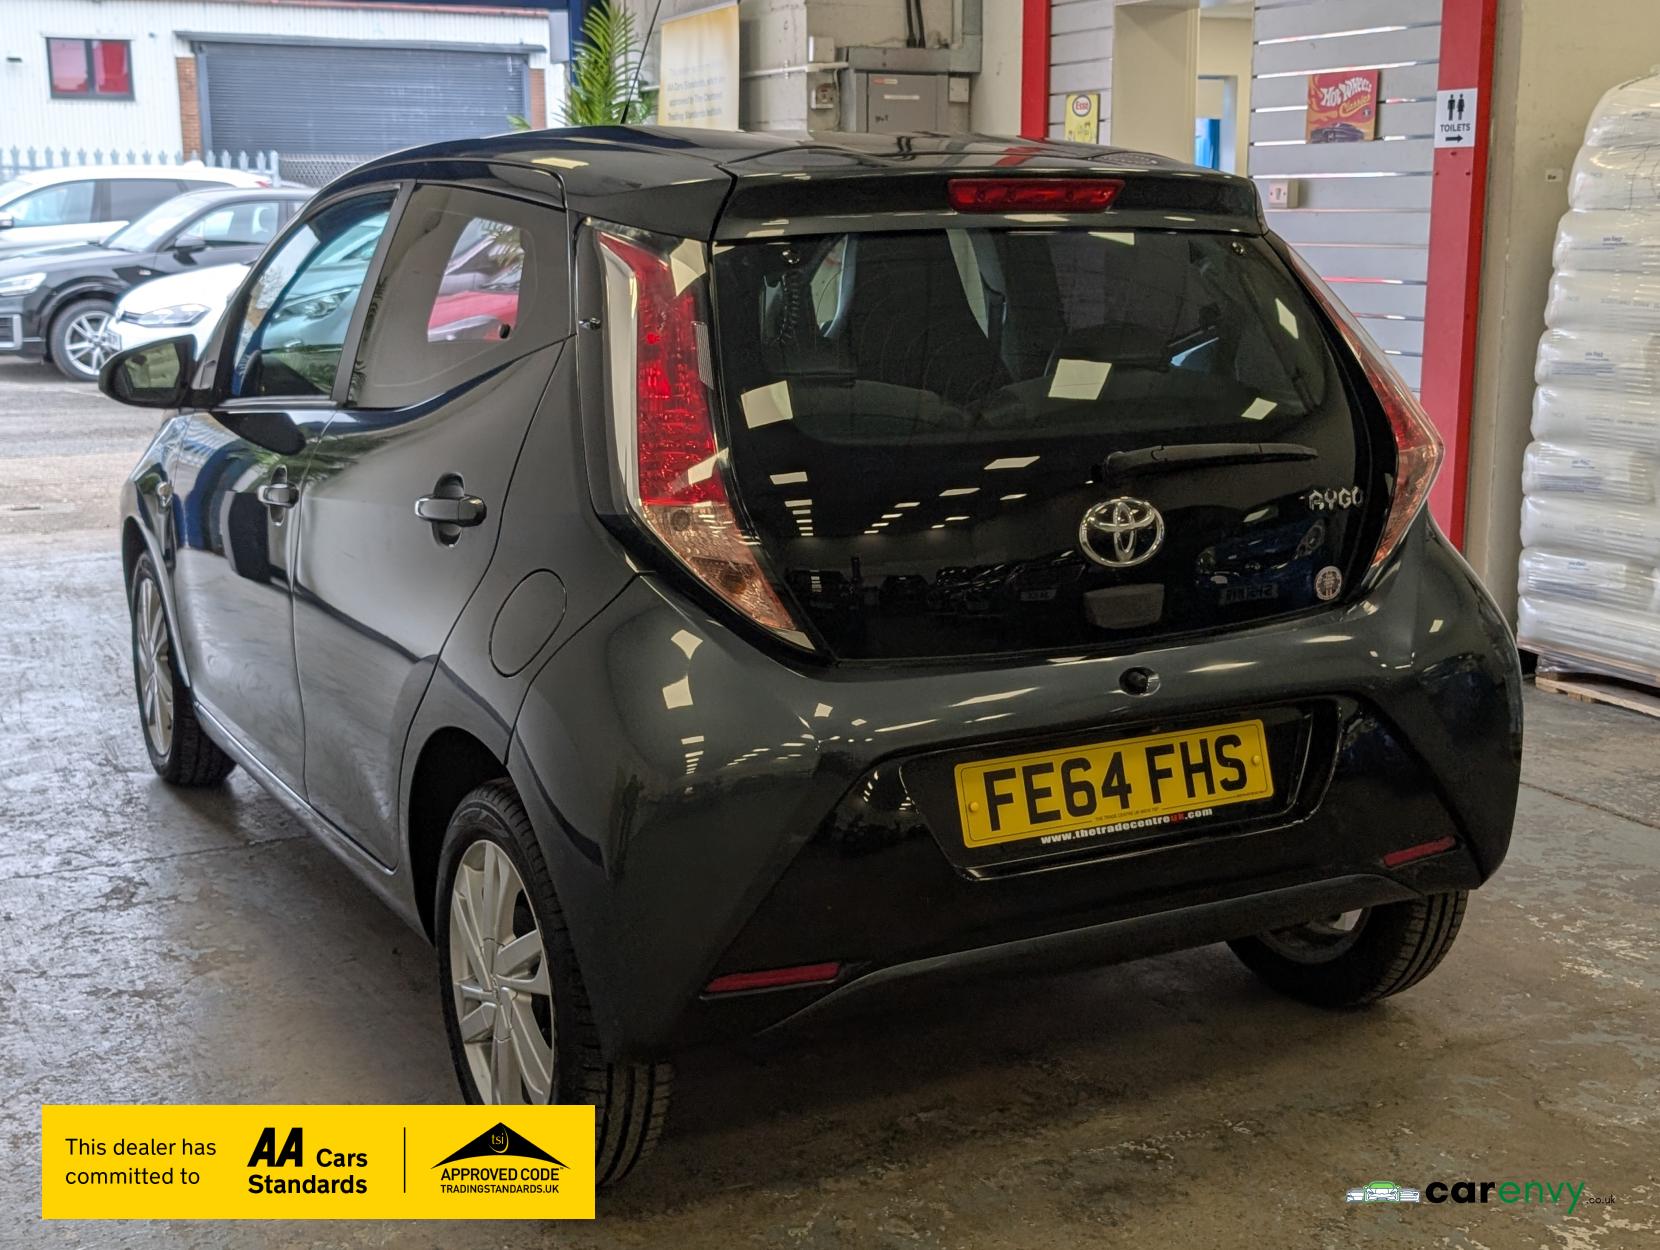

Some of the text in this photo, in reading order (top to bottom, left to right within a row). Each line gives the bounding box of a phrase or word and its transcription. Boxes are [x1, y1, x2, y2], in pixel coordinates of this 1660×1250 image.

[1440, 123, 1471, 132] TOILETS
[1308, 486, 1363, 511] AYGO
[983, 734, 1247, 832] FE64 FHS
[1041, 807, 1213, 844] www.thetradecentreuk.com
